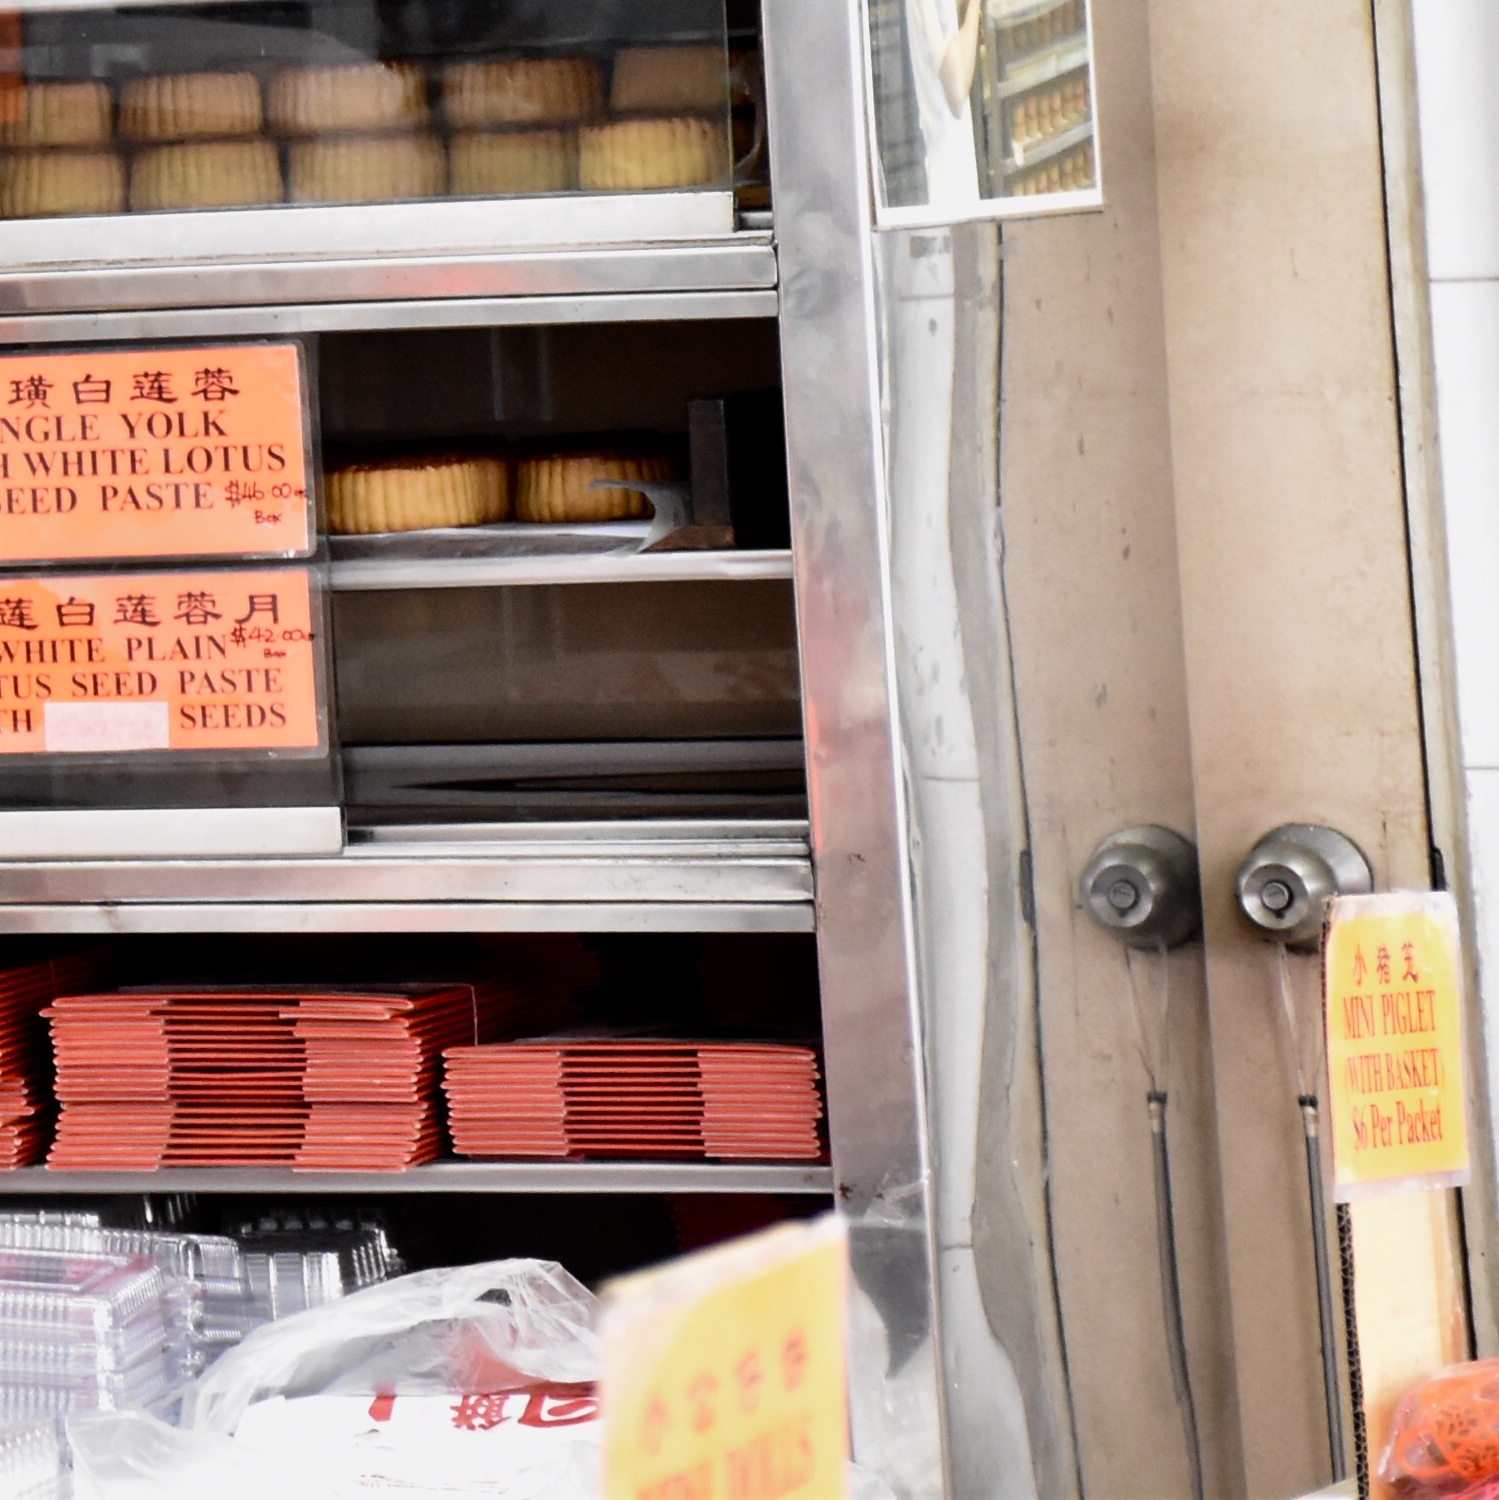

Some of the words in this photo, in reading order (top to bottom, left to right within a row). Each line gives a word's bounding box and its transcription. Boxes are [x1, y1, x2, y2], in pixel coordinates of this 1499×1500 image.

[120, 409, 228, 440] YOLK
[25, 448, 149, 478] WHITE
[163, 444, 286, 475] LOTUS
[101, 483, 214, 512] PASTE
[126, 634, 228, 661] PLAIN
[71, 672, 157, 698] SEED
[179, 668, 282, 695] PASTE
[180, 703, 287, 730] SEEDS
[1343, 995, 1377, 1039] MINI
[1381, 990, 1436, 1036] PIGLET
[1371, 1104, 1393, 1148] Per
[1396, 1100, 1443, 1145] Packet
